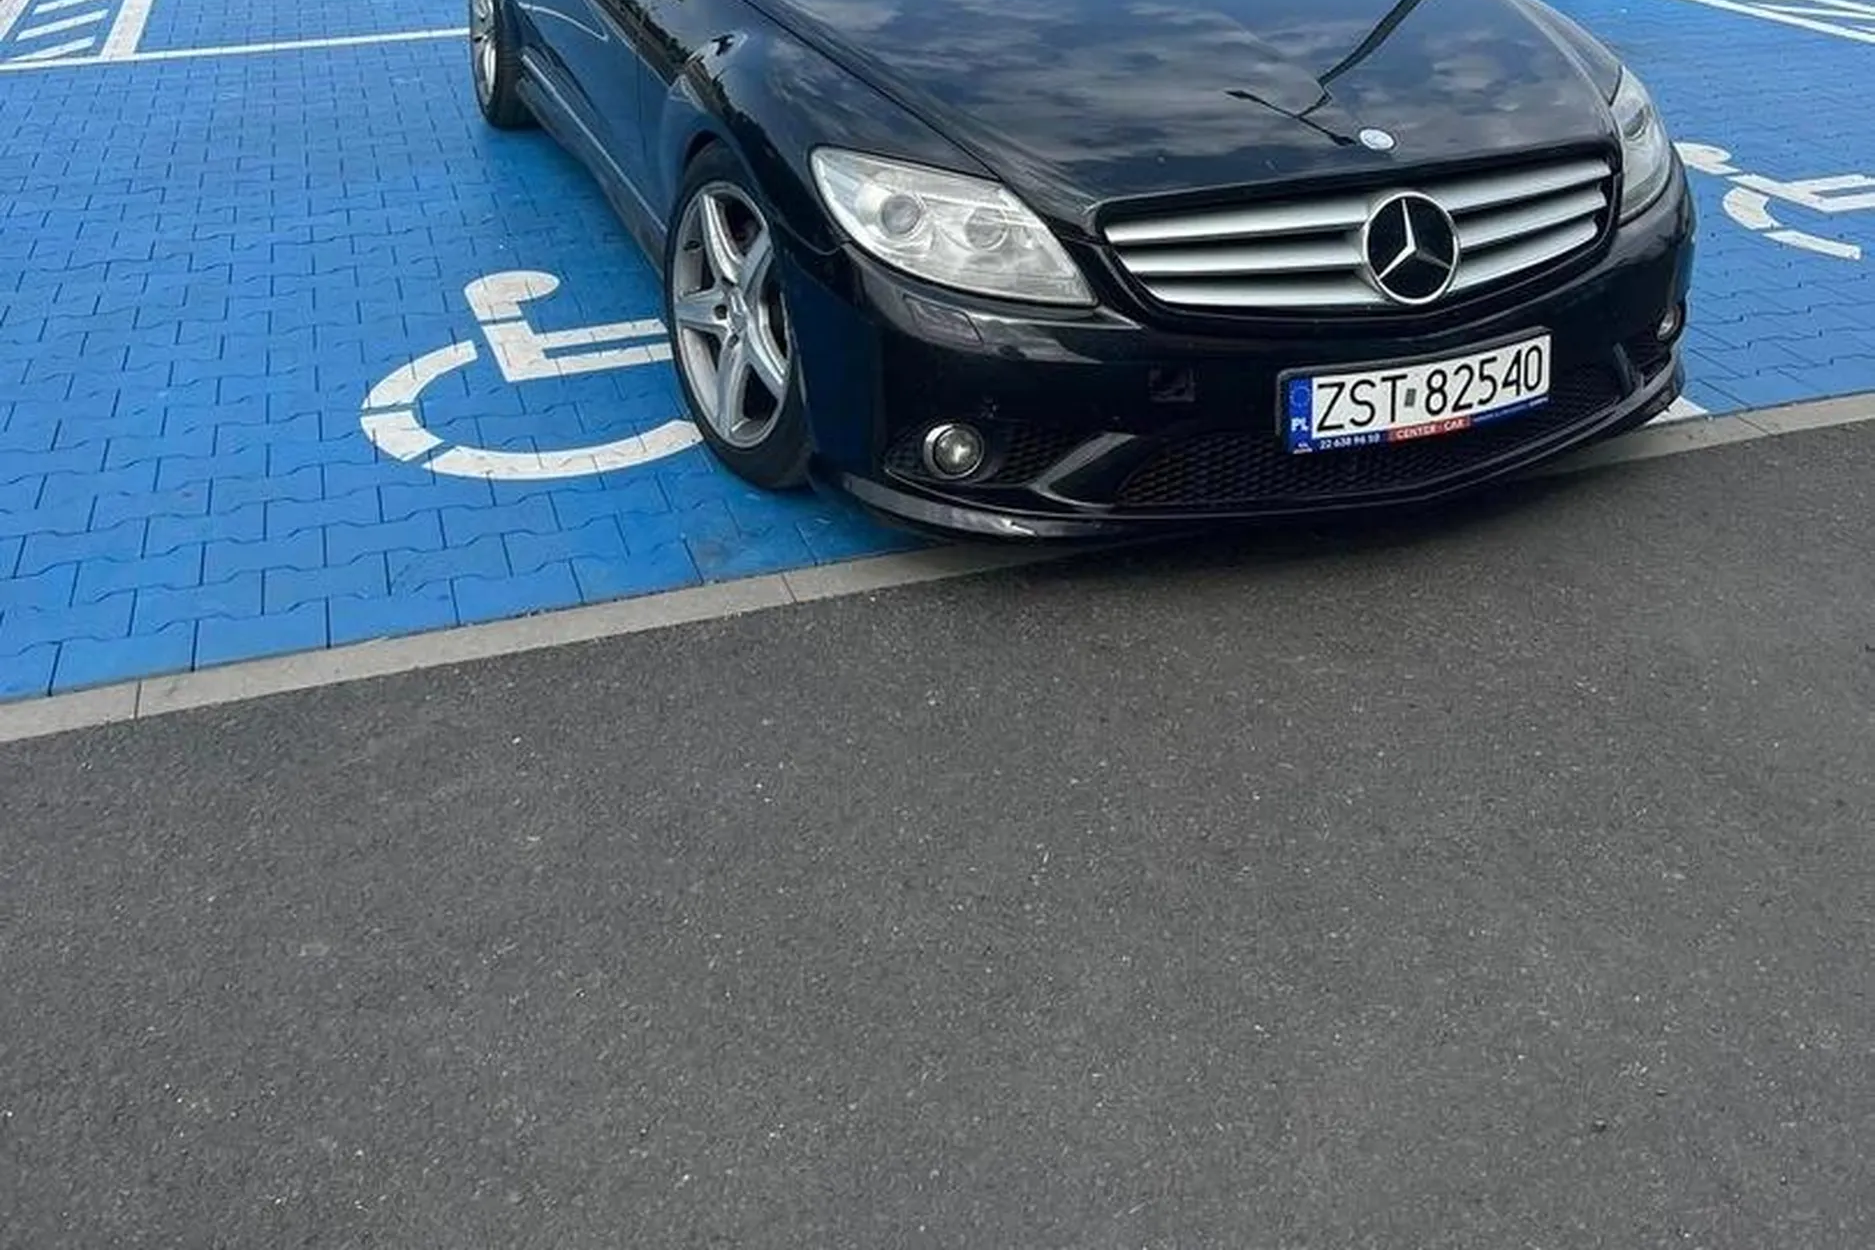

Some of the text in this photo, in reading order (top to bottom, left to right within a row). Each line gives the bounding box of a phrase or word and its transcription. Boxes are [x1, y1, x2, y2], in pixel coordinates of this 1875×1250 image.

[1316, 374, 1408, 432] ZST
[1425, 345, 1544, 416] 82540
[1291, 418, 1309, 432] PL
